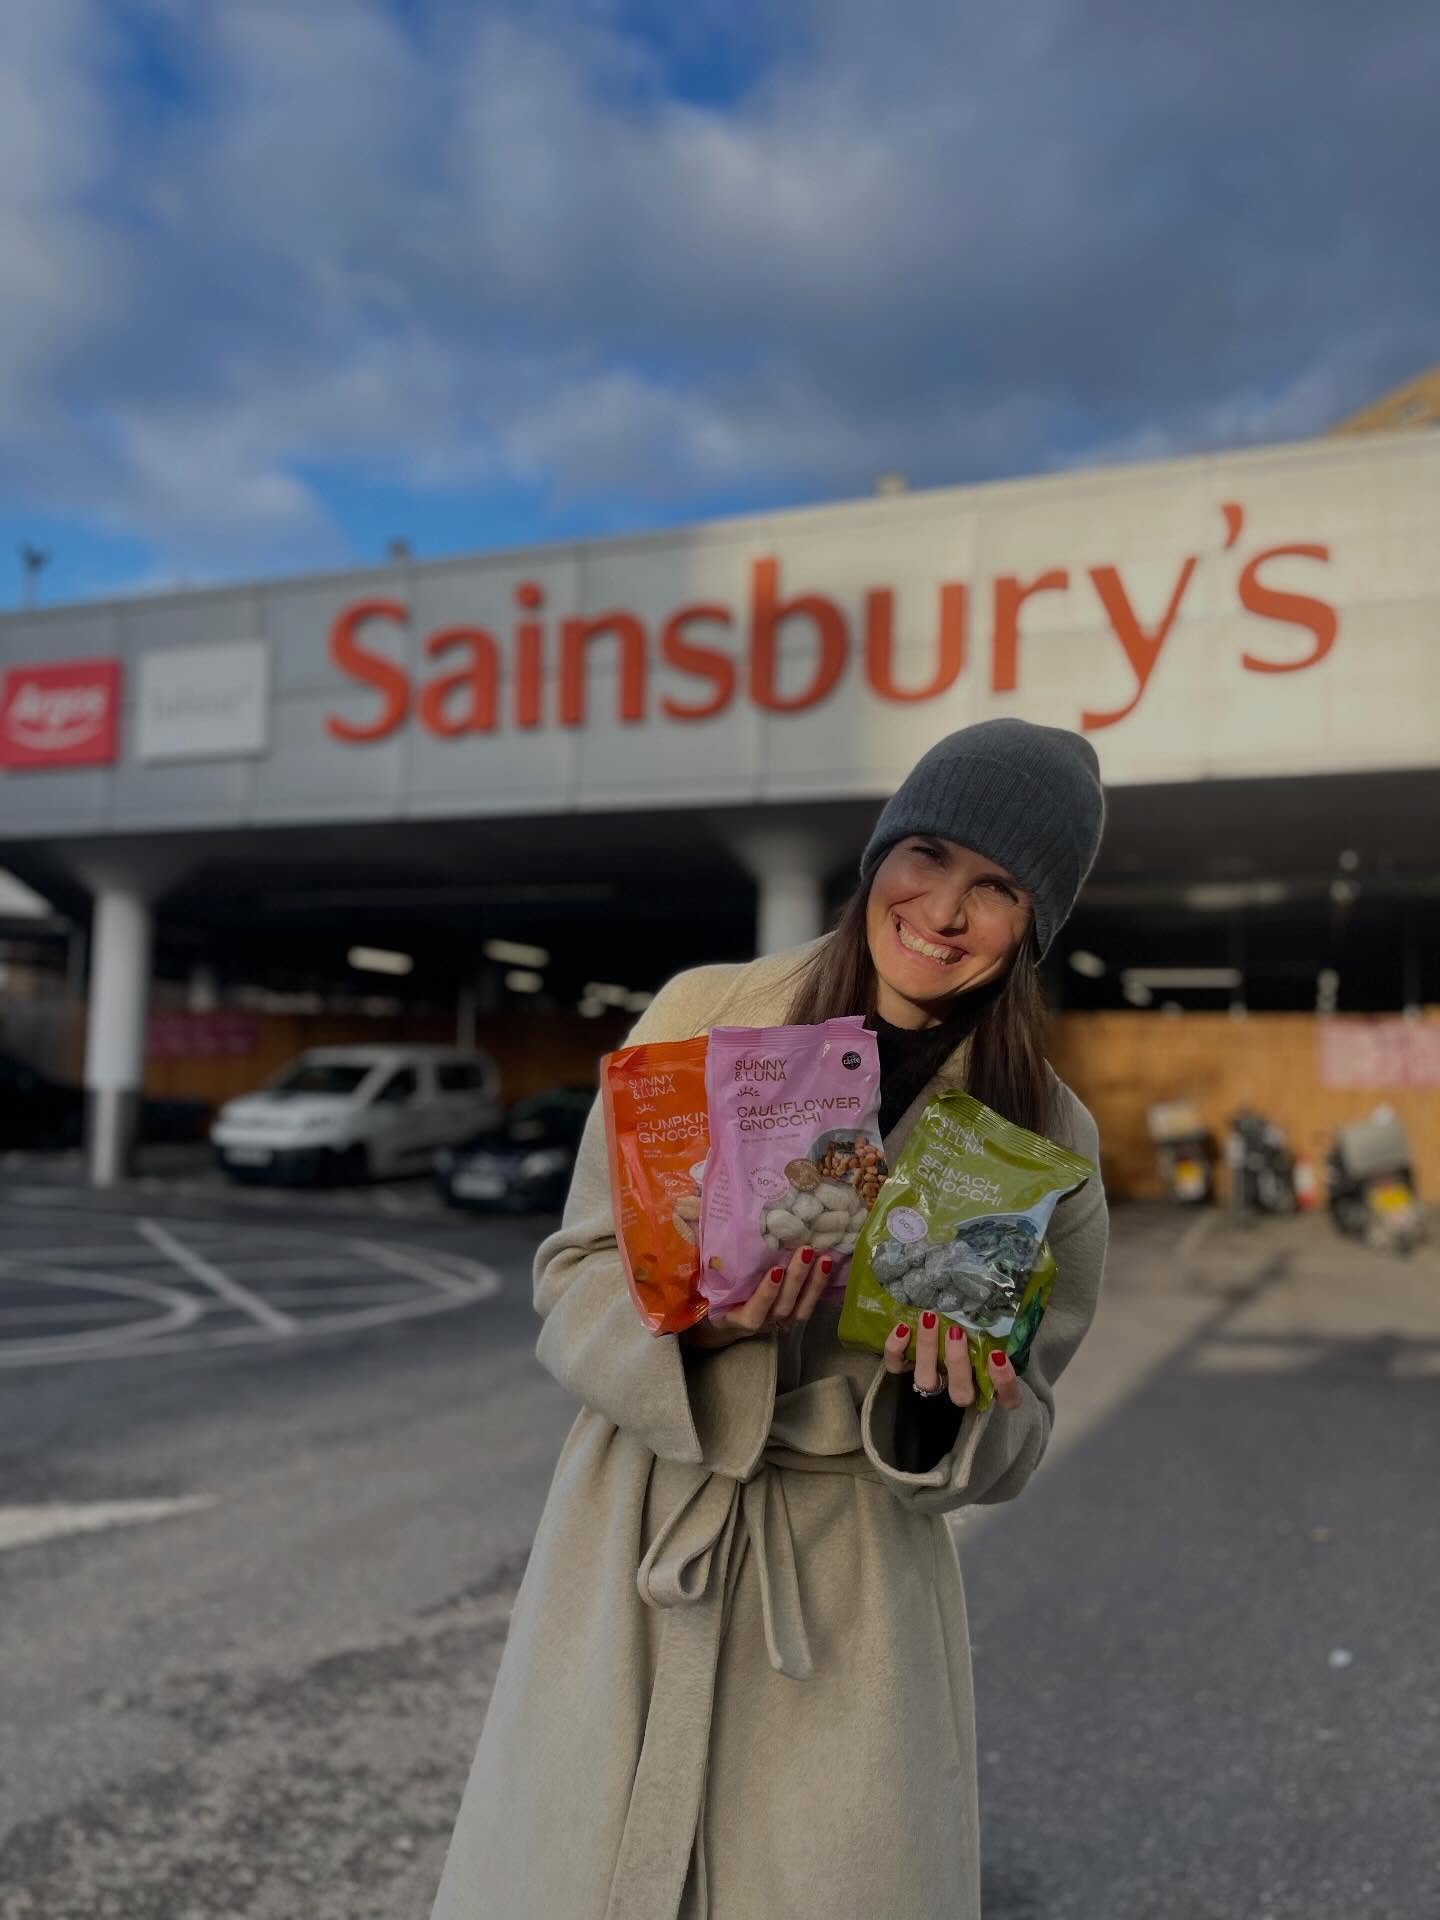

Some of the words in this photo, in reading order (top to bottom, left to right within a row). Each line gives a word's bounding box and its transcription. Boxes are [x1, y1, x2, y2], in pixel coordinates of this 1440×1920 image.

[325, 503, 1339, 743] Sainsbury's
[735, 1060, 788, 1071] SUNNY
[629, 1074, 674, 1089] SUNNY
[737, 1096, 861, 1119] CAULIFLOWER
[637, 1111, 710, 1131] PUMPKIN
[740, 1112, 822, 1132] GNOCCHI
[639, 1124, 711, 1144] GNOCCH
[921, 1154, 1000, 1195] SPINACH
[917, 1164, 1002, 1207] GNOCCHI
